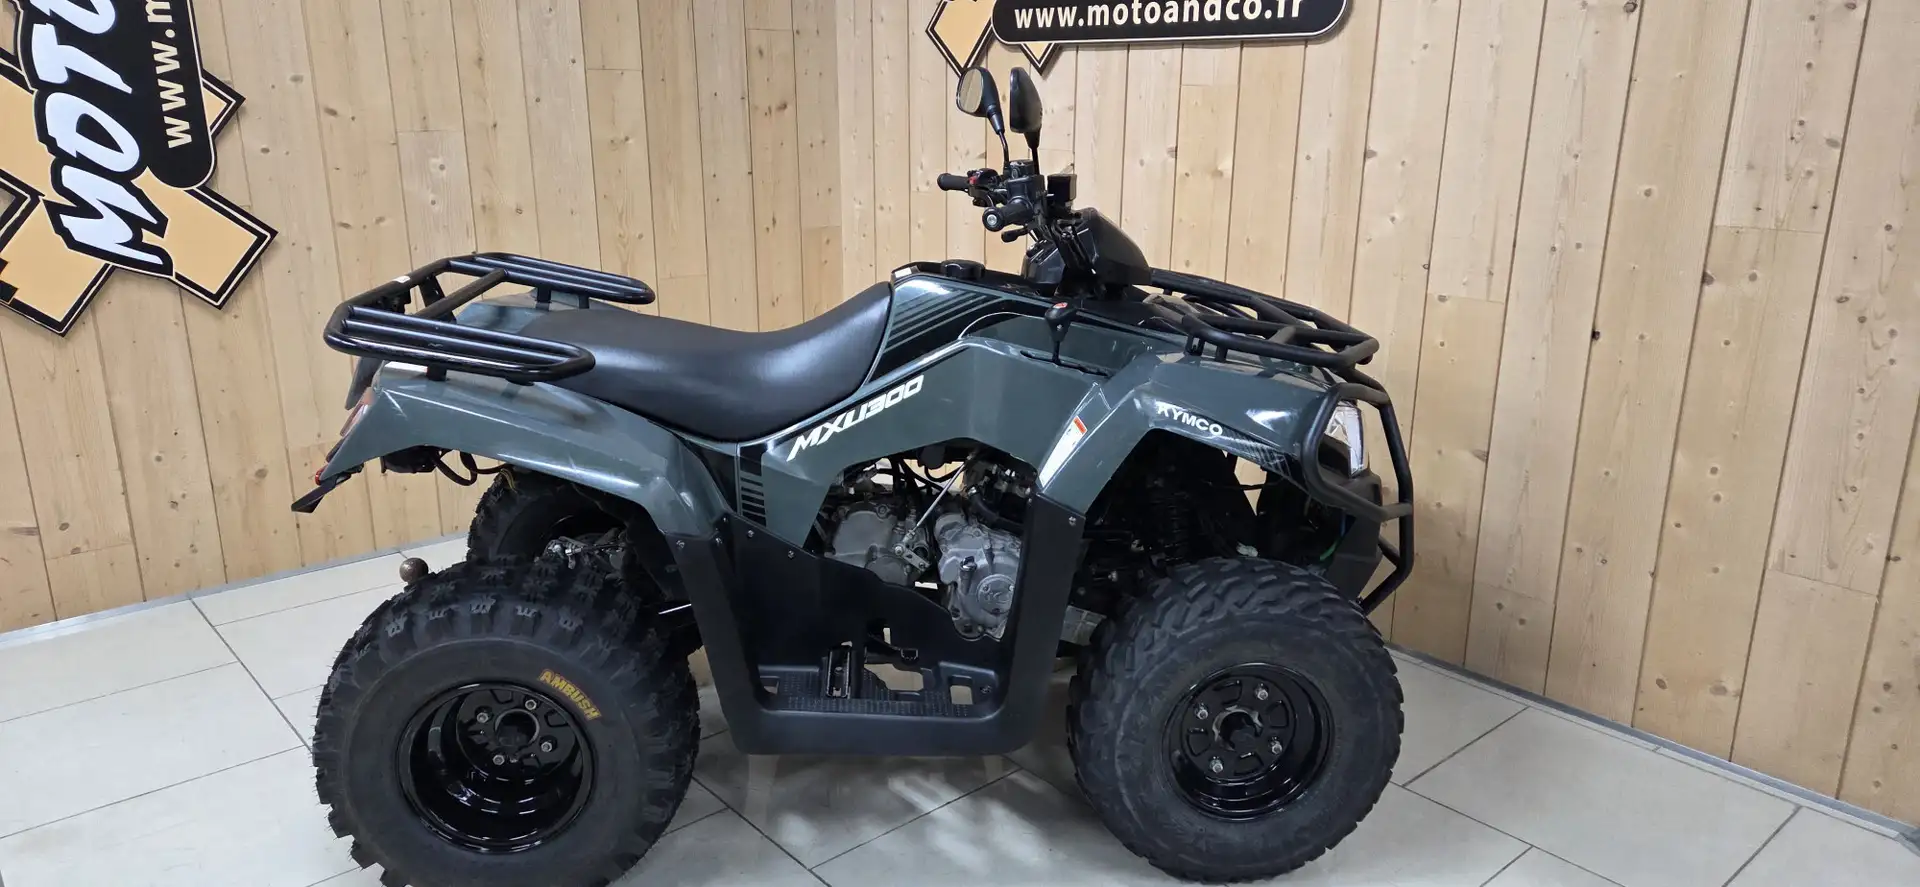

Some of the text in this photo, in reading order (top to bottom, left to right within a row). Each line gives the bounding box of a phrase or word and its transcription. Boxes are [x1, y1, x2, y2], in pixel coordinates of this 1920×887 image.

[1015, 0, 1302, 28] www.motoandco.fr
[787, 375, 924, 462] MXU300
[538, 669, 601, 720] AMBUSH
